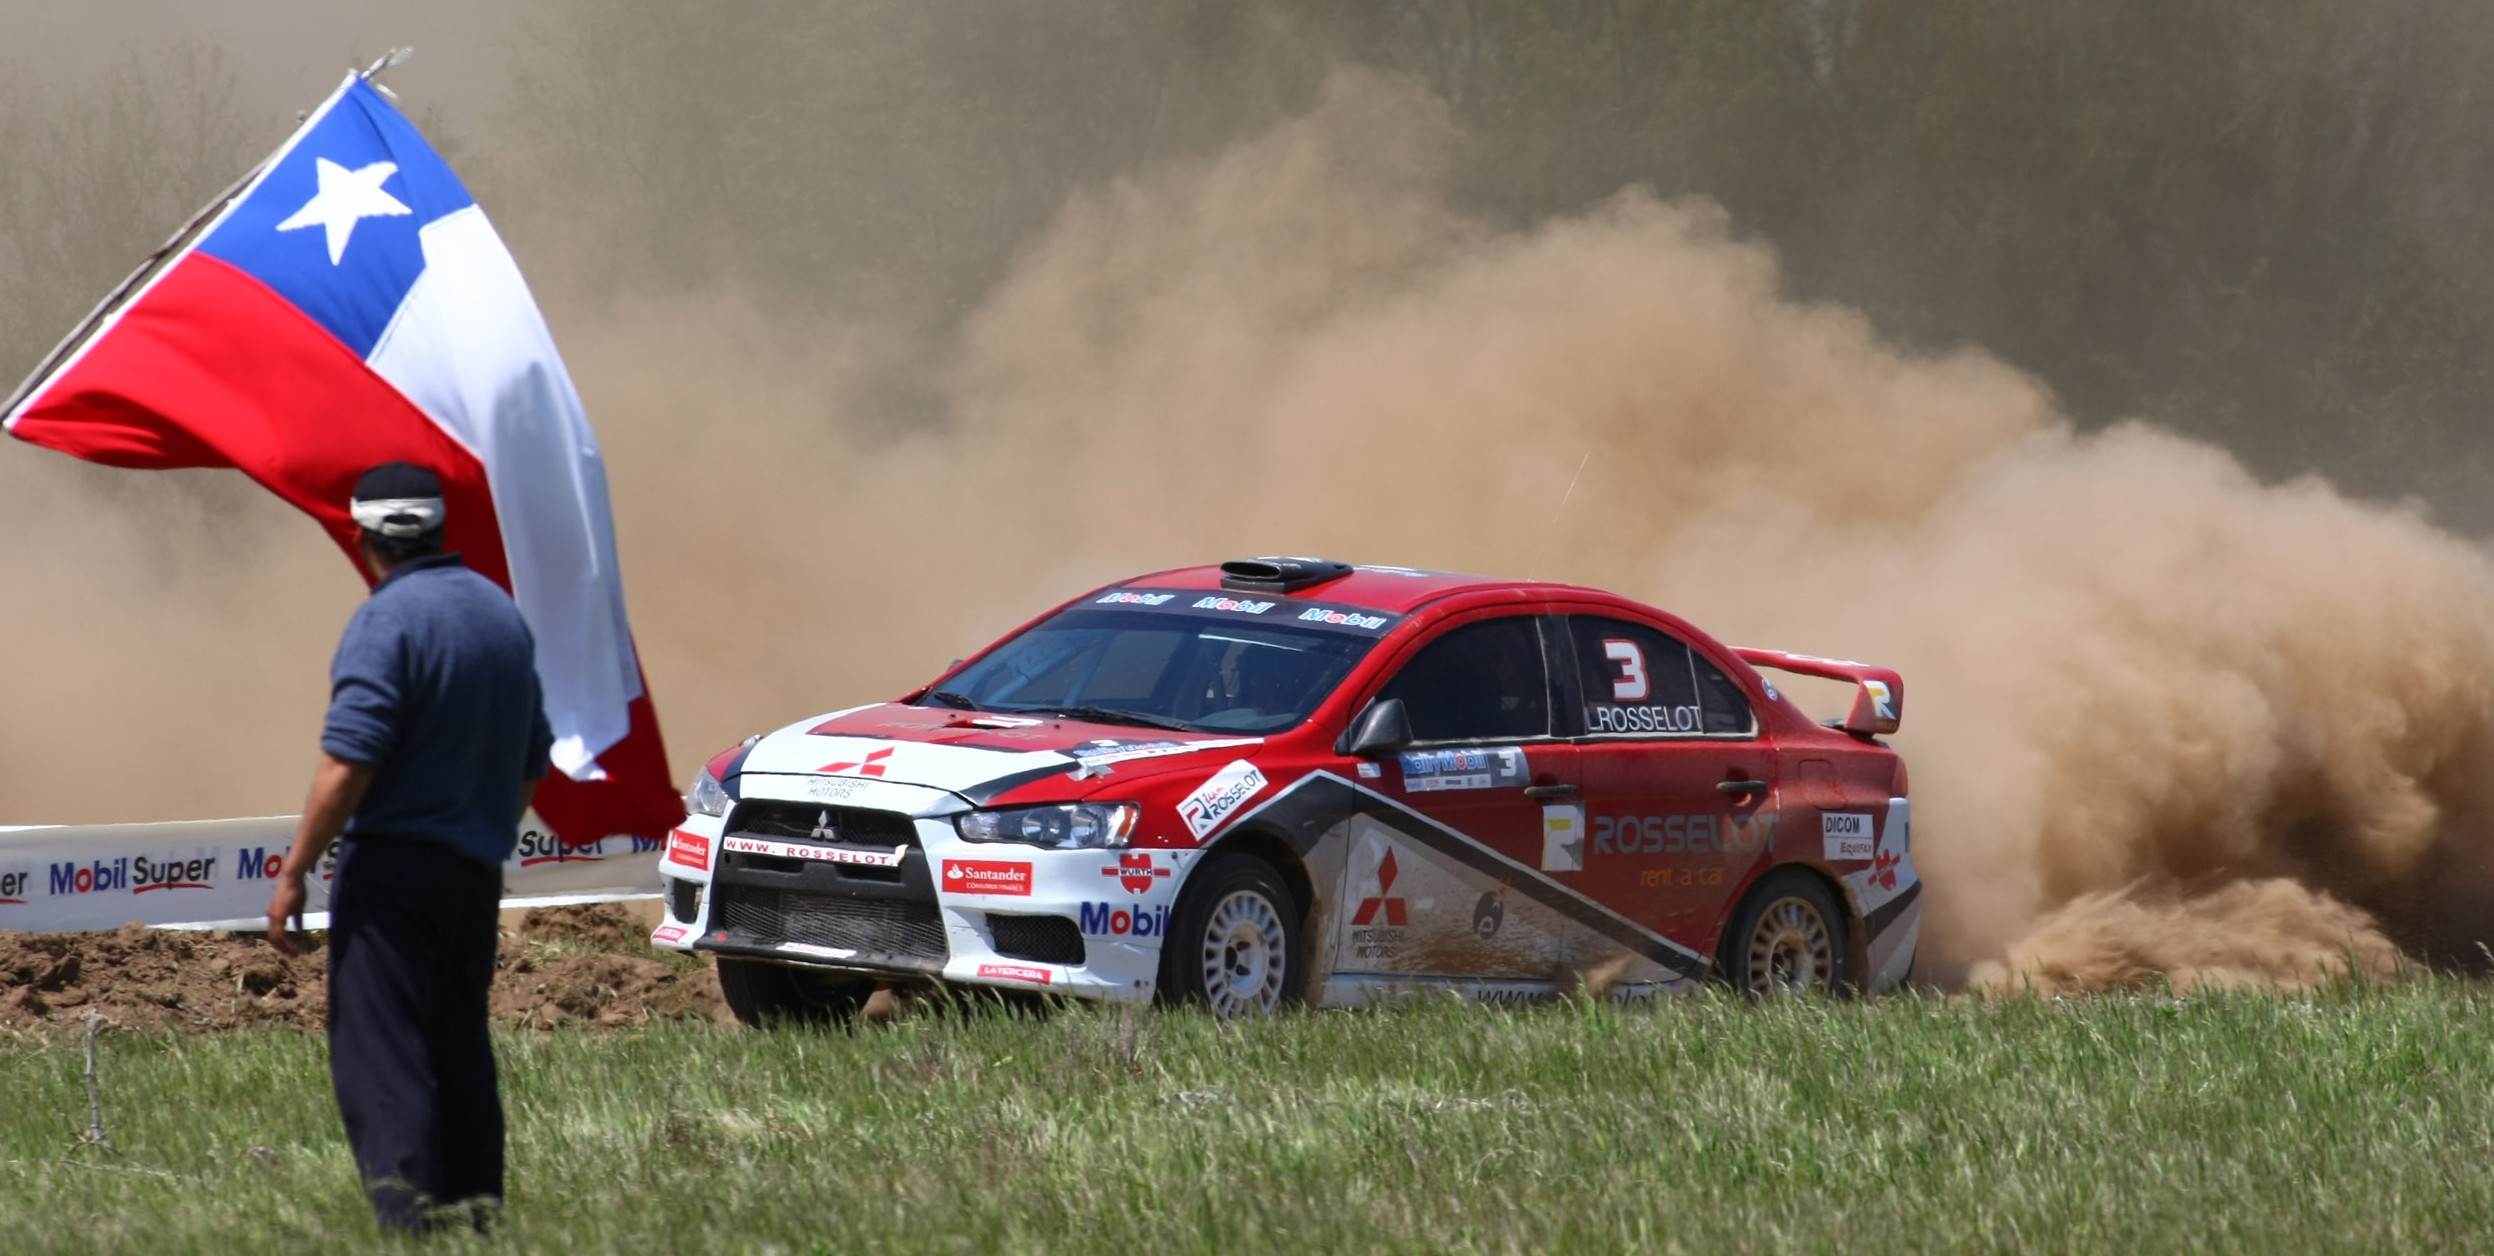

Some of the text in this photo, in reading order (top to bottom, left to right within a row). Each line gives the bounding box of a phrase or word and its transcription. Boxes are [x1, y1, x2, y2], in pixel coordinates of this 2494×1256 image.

[1192, 596, 1275, 614] Mobil
[1298, 608, 1387, 629] Mobil
[1603, 638, 1650, 702] 3
[1499, 752, 1517, 776] 3
[806, 777, 869, 788] MITSUBISHI
[808, 787, 852, 798] MOTORS
[1209, 770, 1261, 817] ROSSELOT
[1593, 814, 1780, 855] ROSSELOT
[1825, 817, 1860, 833] DICOM
[50, 857, 127, 896] Mobil
[132, 856, 215, 890] Super
[965, 867, 1026, 881] Santander
[1640, 866, 1727, 888] rent a car
[1081, 901, 1171, 937] Mobil
